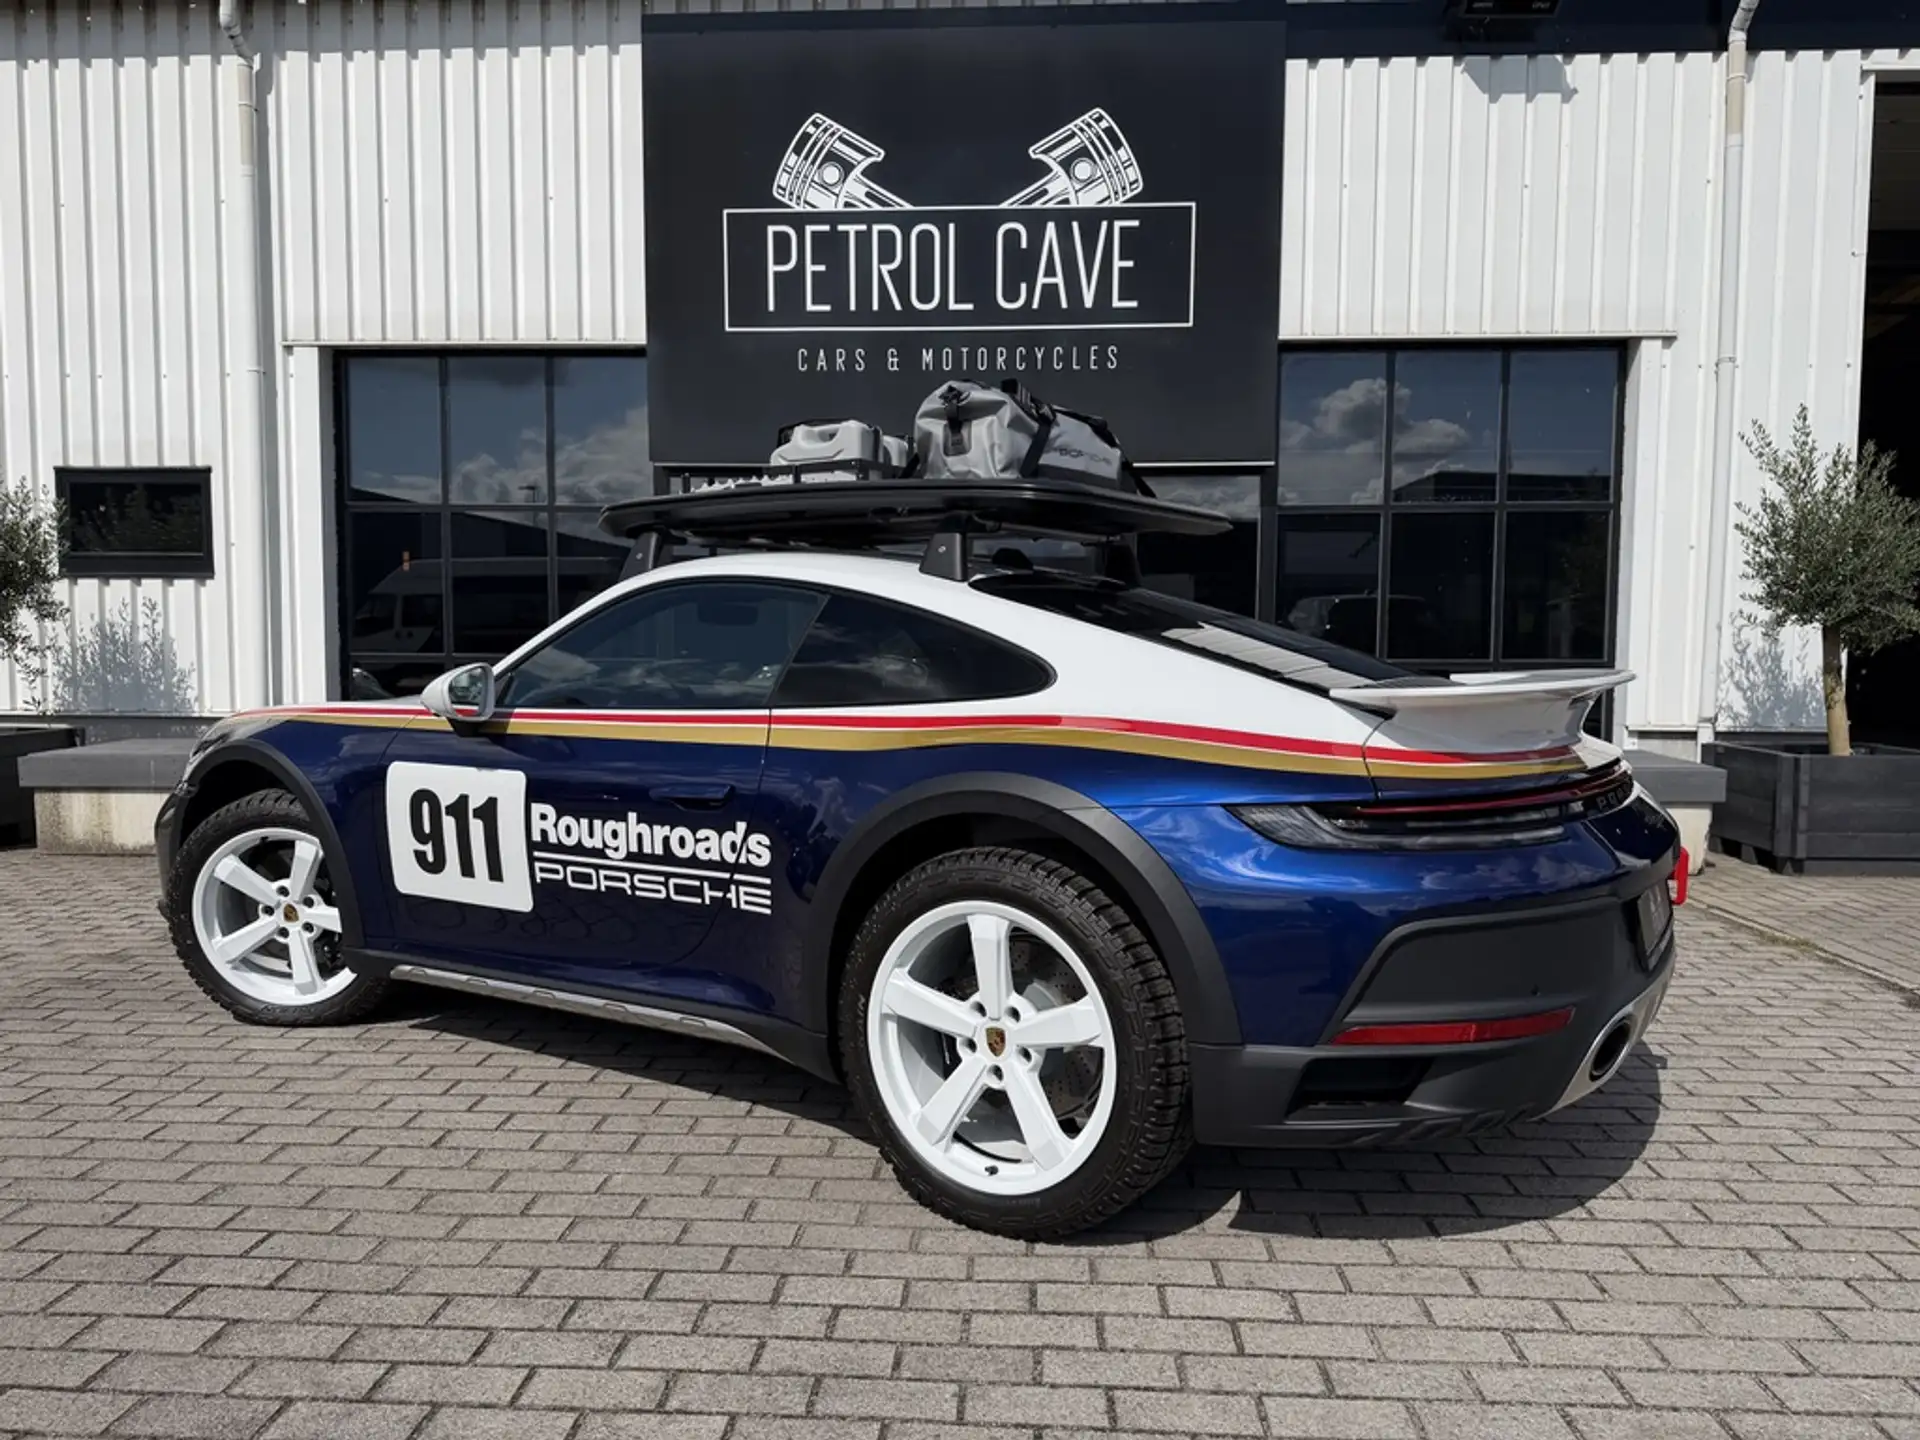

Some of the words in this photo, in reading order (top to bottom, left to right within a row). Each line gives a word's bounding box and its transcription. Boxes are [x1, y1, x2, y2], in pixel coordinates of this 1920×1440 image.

[767, 223, 975, 312] PETROL
[996, 220, 1140, 309] CAVE
[797, 349, 866, 372] CARS
[887, 348, 900, 371] &
[922, 346, 1119, 371] MOTORCYCLES
[409, 788, 503, 883] 911
[531, 803, 772, 867] Roughroads
[534, 861, 772, 915] PORSCHE
